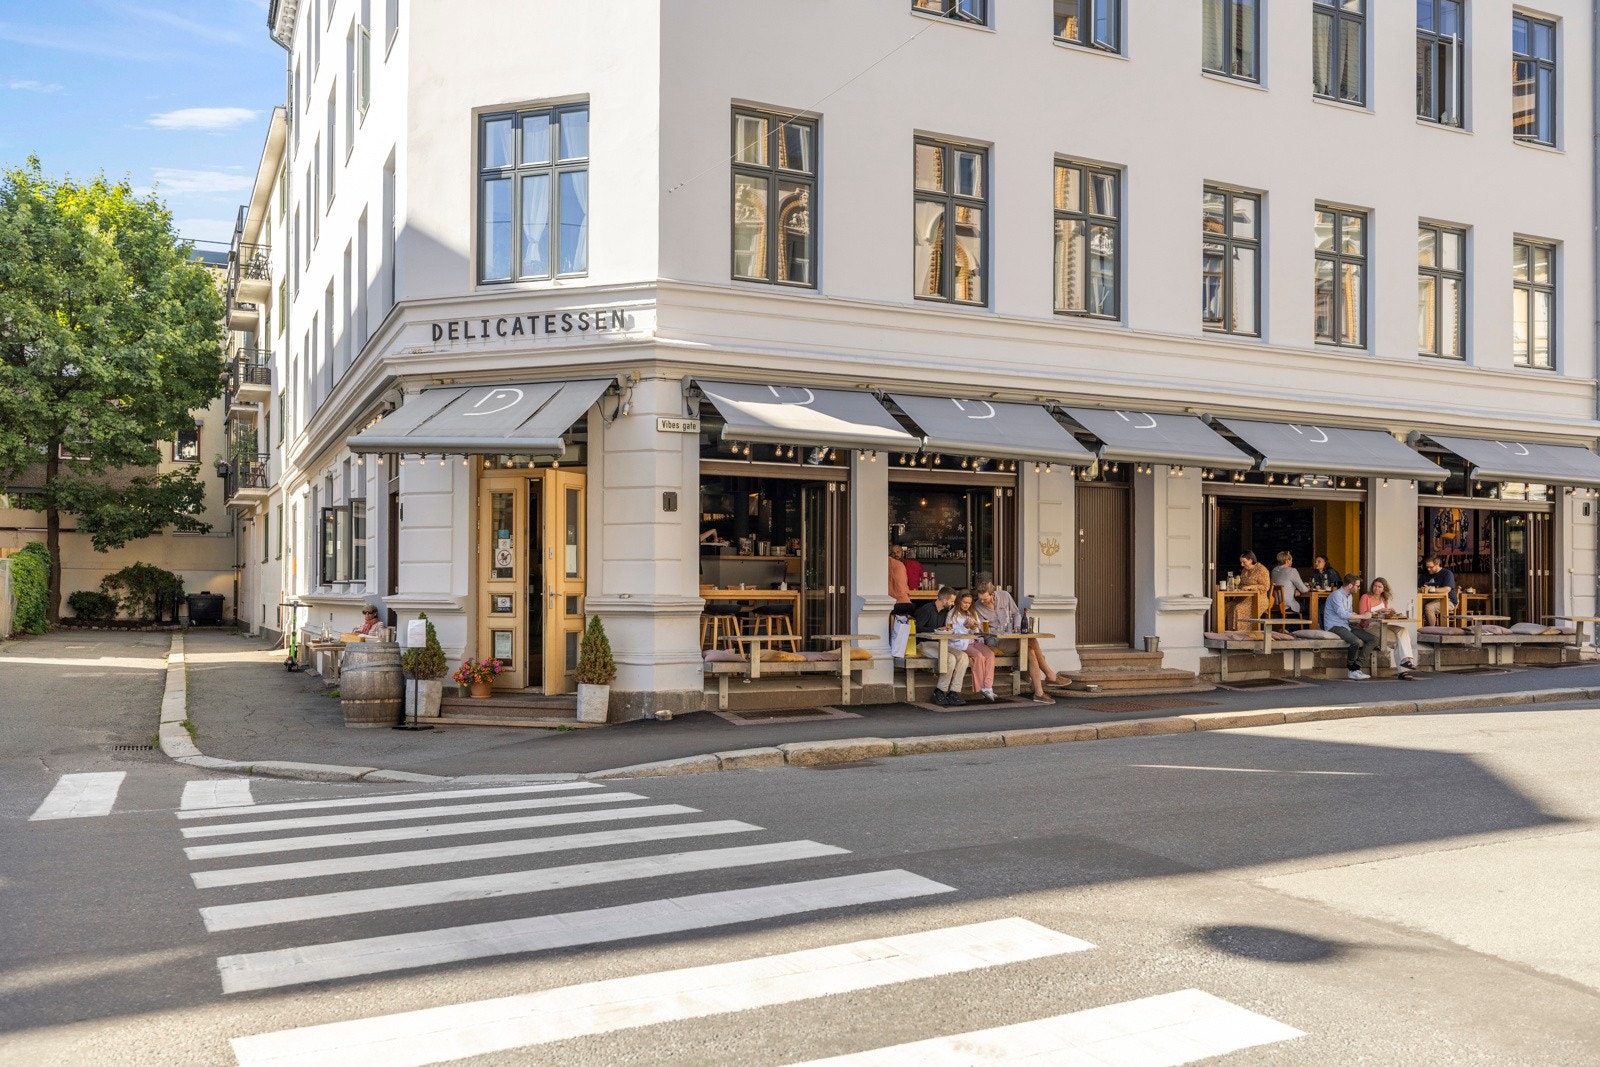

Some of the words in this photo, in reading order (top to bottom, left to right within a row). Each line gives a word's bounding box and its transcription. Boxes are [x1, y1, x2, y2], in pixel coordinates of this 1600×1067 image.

[432, 308, 625, 342] DELICATESSEN
[661, 419, 680, 429] Vibes
[682, 421, 697, 431] gate
